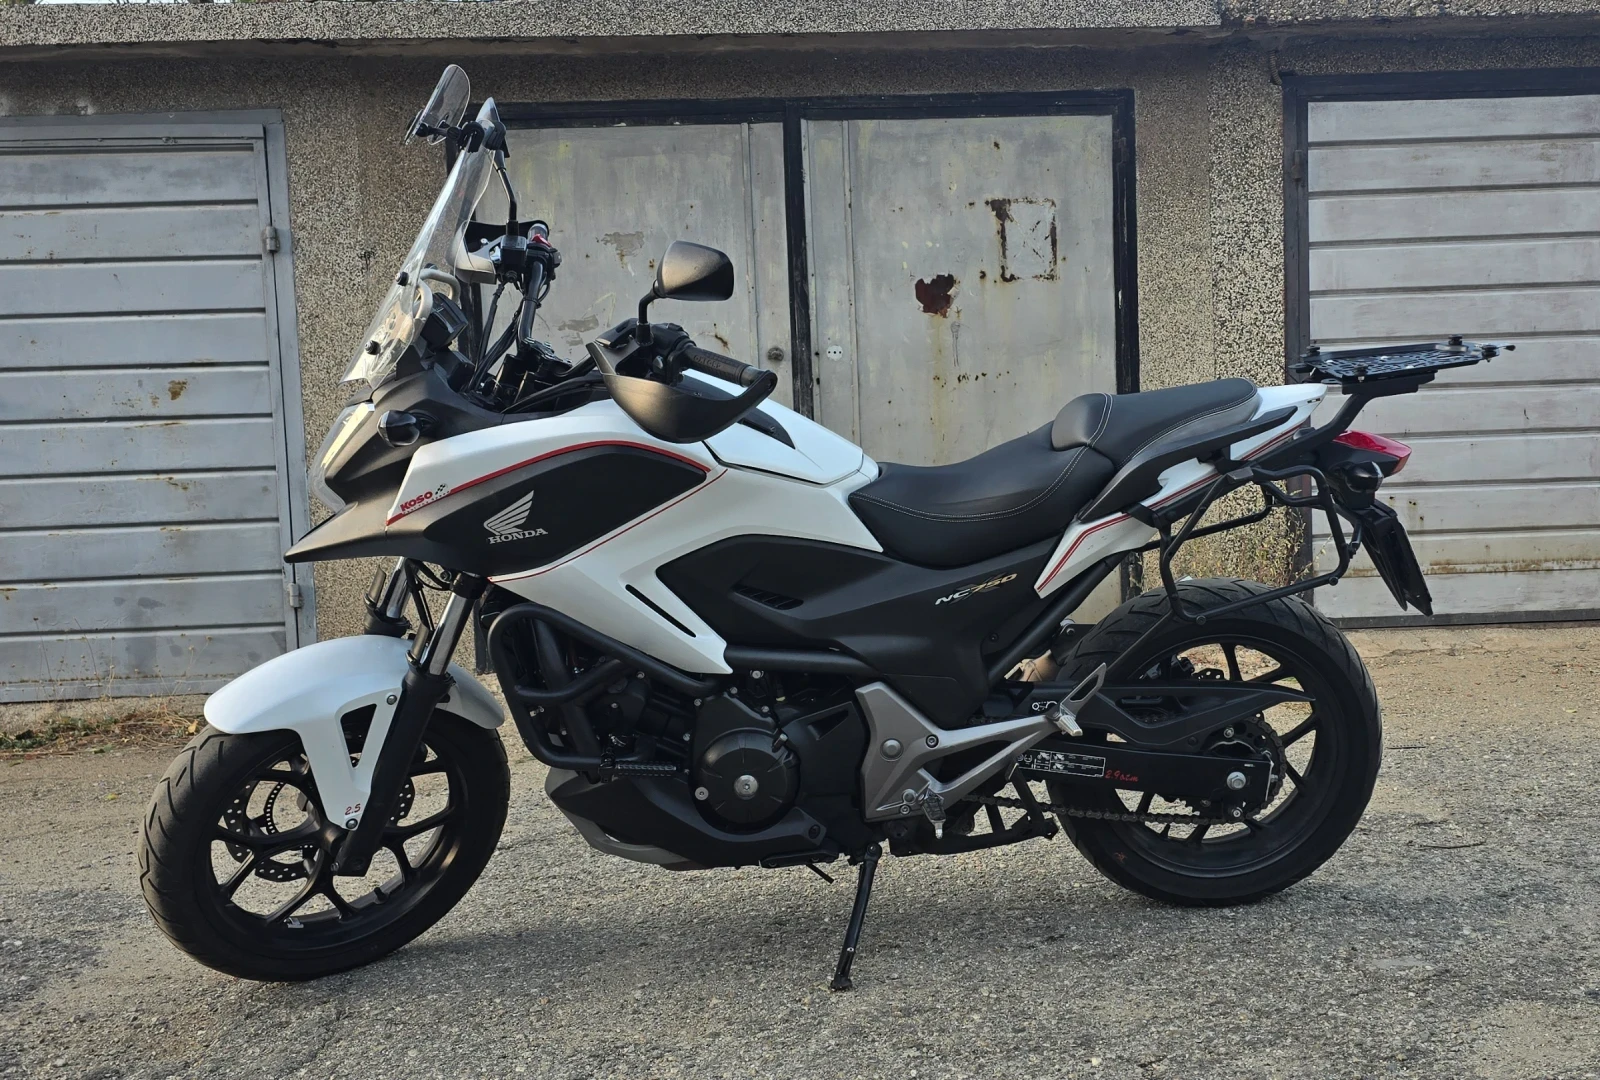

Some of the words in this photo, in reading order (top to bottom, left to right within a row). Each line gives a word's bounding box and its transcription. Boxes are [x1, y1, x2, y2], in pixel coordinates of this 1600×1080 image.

[400, 491, 433, 511] KOSO
[488, 528, 549, 544] HONDA
[345, 803, 361, 815] 2.5
